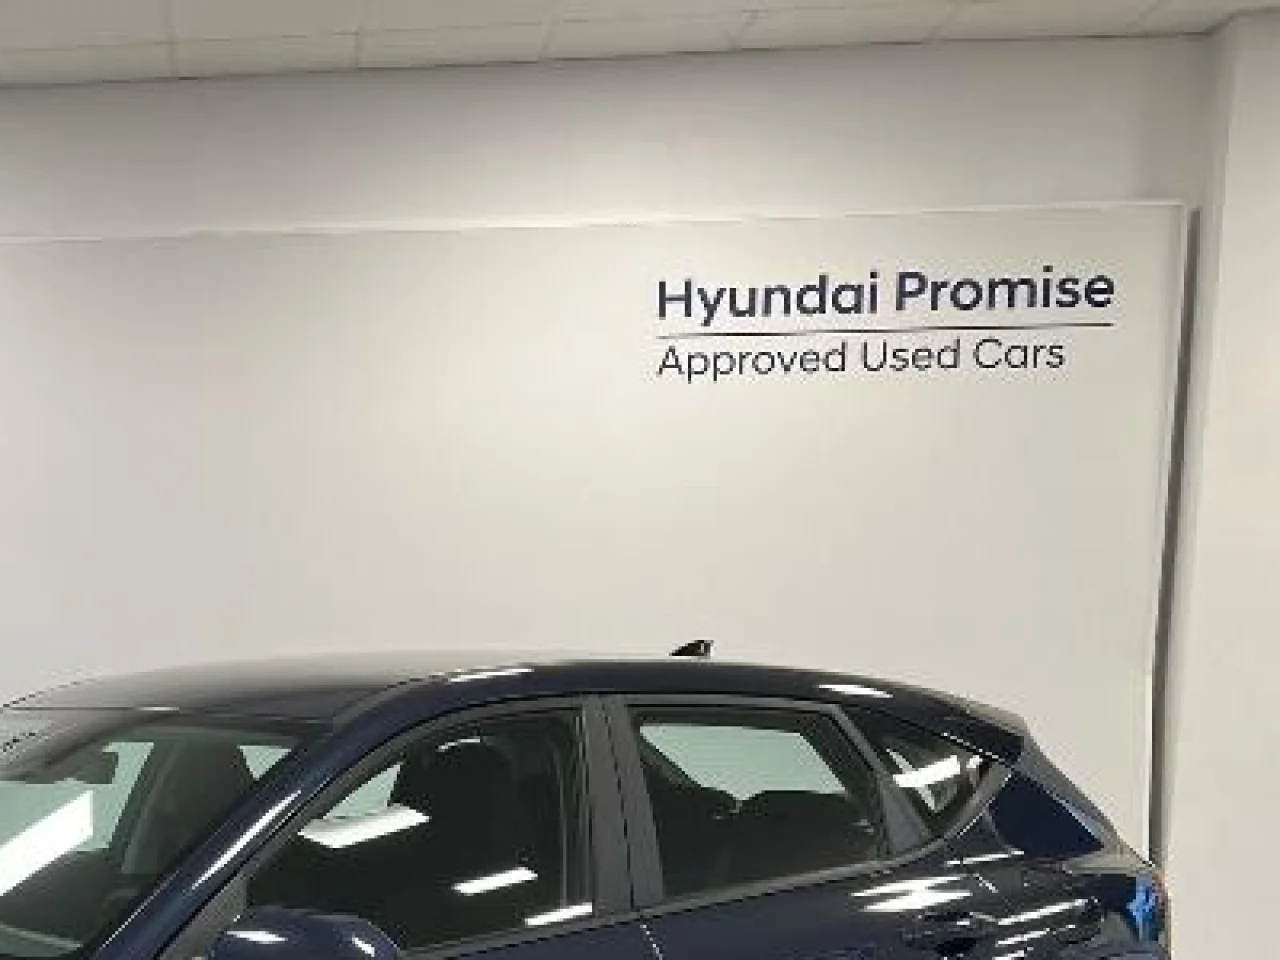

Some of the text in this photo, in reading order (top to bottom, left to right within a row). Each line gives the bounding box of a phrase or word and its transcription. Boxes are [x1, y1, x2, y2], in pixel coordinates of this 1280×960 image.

[657, 264, 1115, 327] Hyundai Promise
[658, 338, 1067, 383] Approved Used Cars
